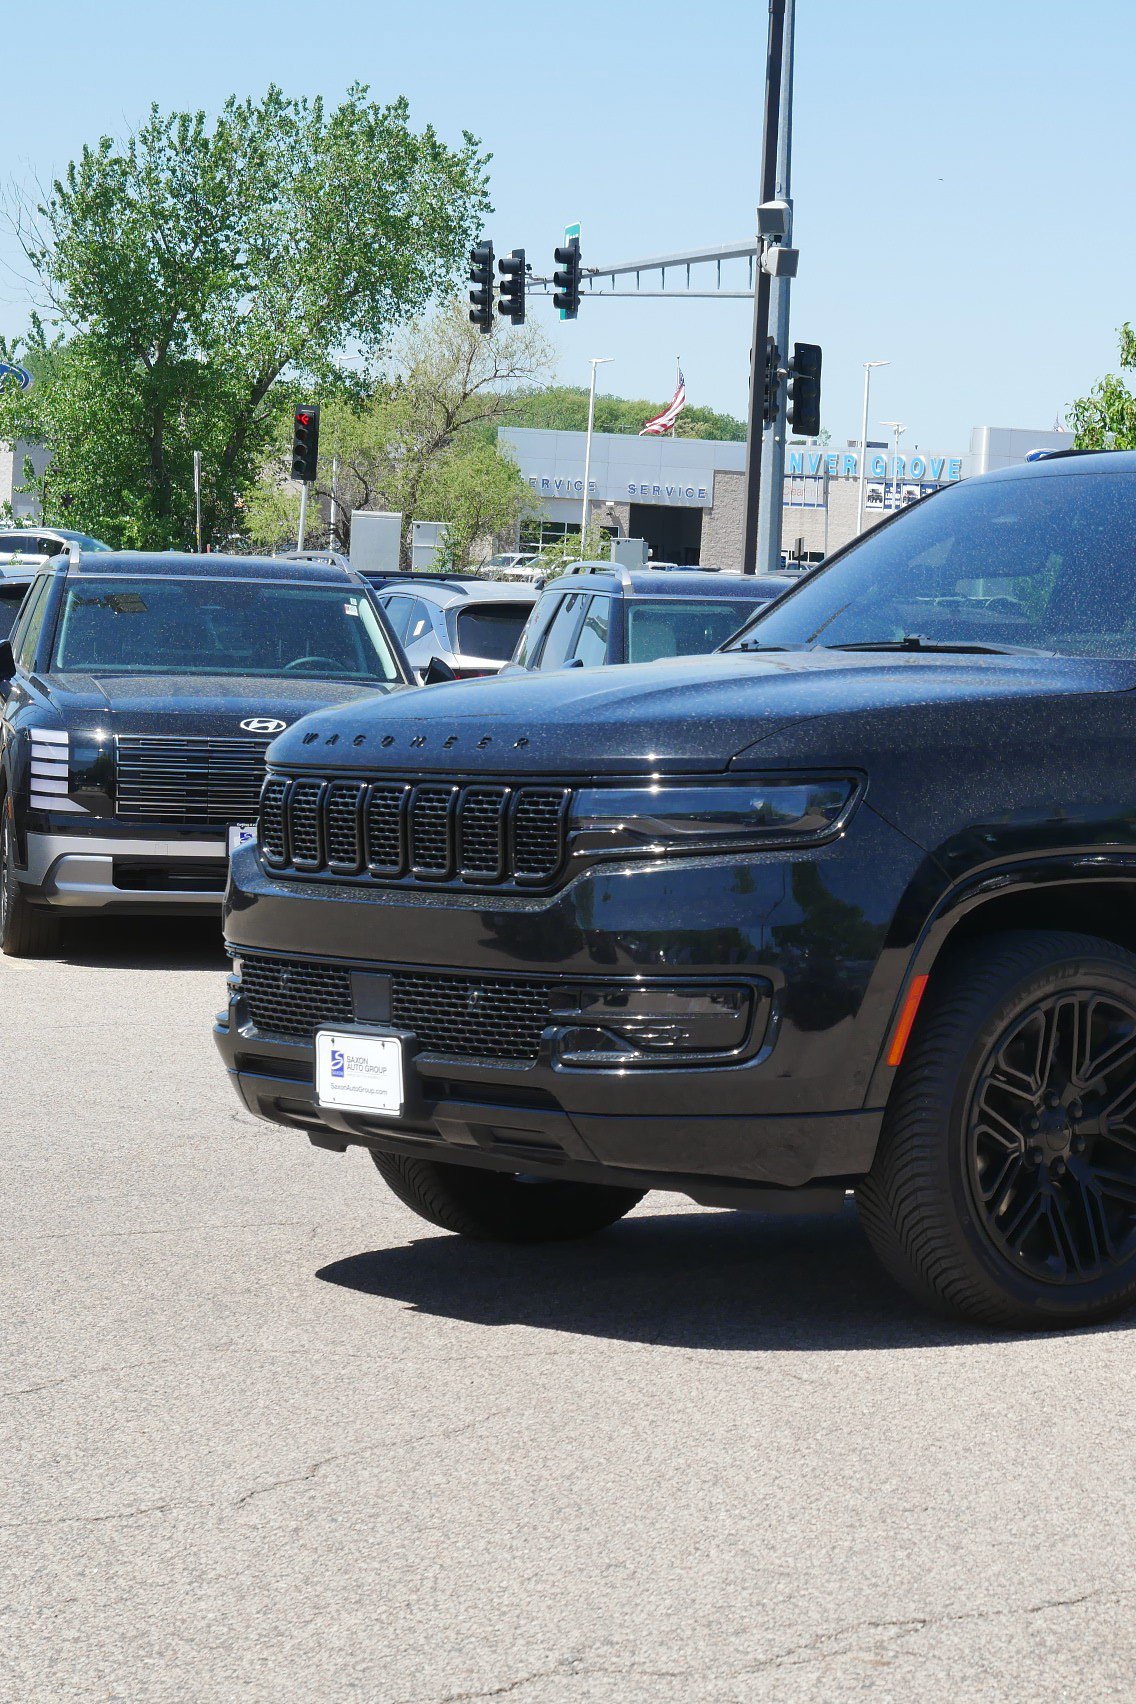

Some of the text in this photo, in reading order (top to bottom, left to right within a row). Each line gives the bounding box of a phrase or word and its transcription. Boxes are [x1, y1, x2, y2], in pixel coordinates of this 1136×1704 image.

[788, 452, 963, 481] NVER GROVE
[528, 477, 597, 492] ERVICE
[627, 483, 708, 499] SERVICE
[302, 732, 530, 750] WAGONEER
[346, 1055, 369, 1065] SAXON
[346, 1062, 388, 1075] AUTO GROUP
